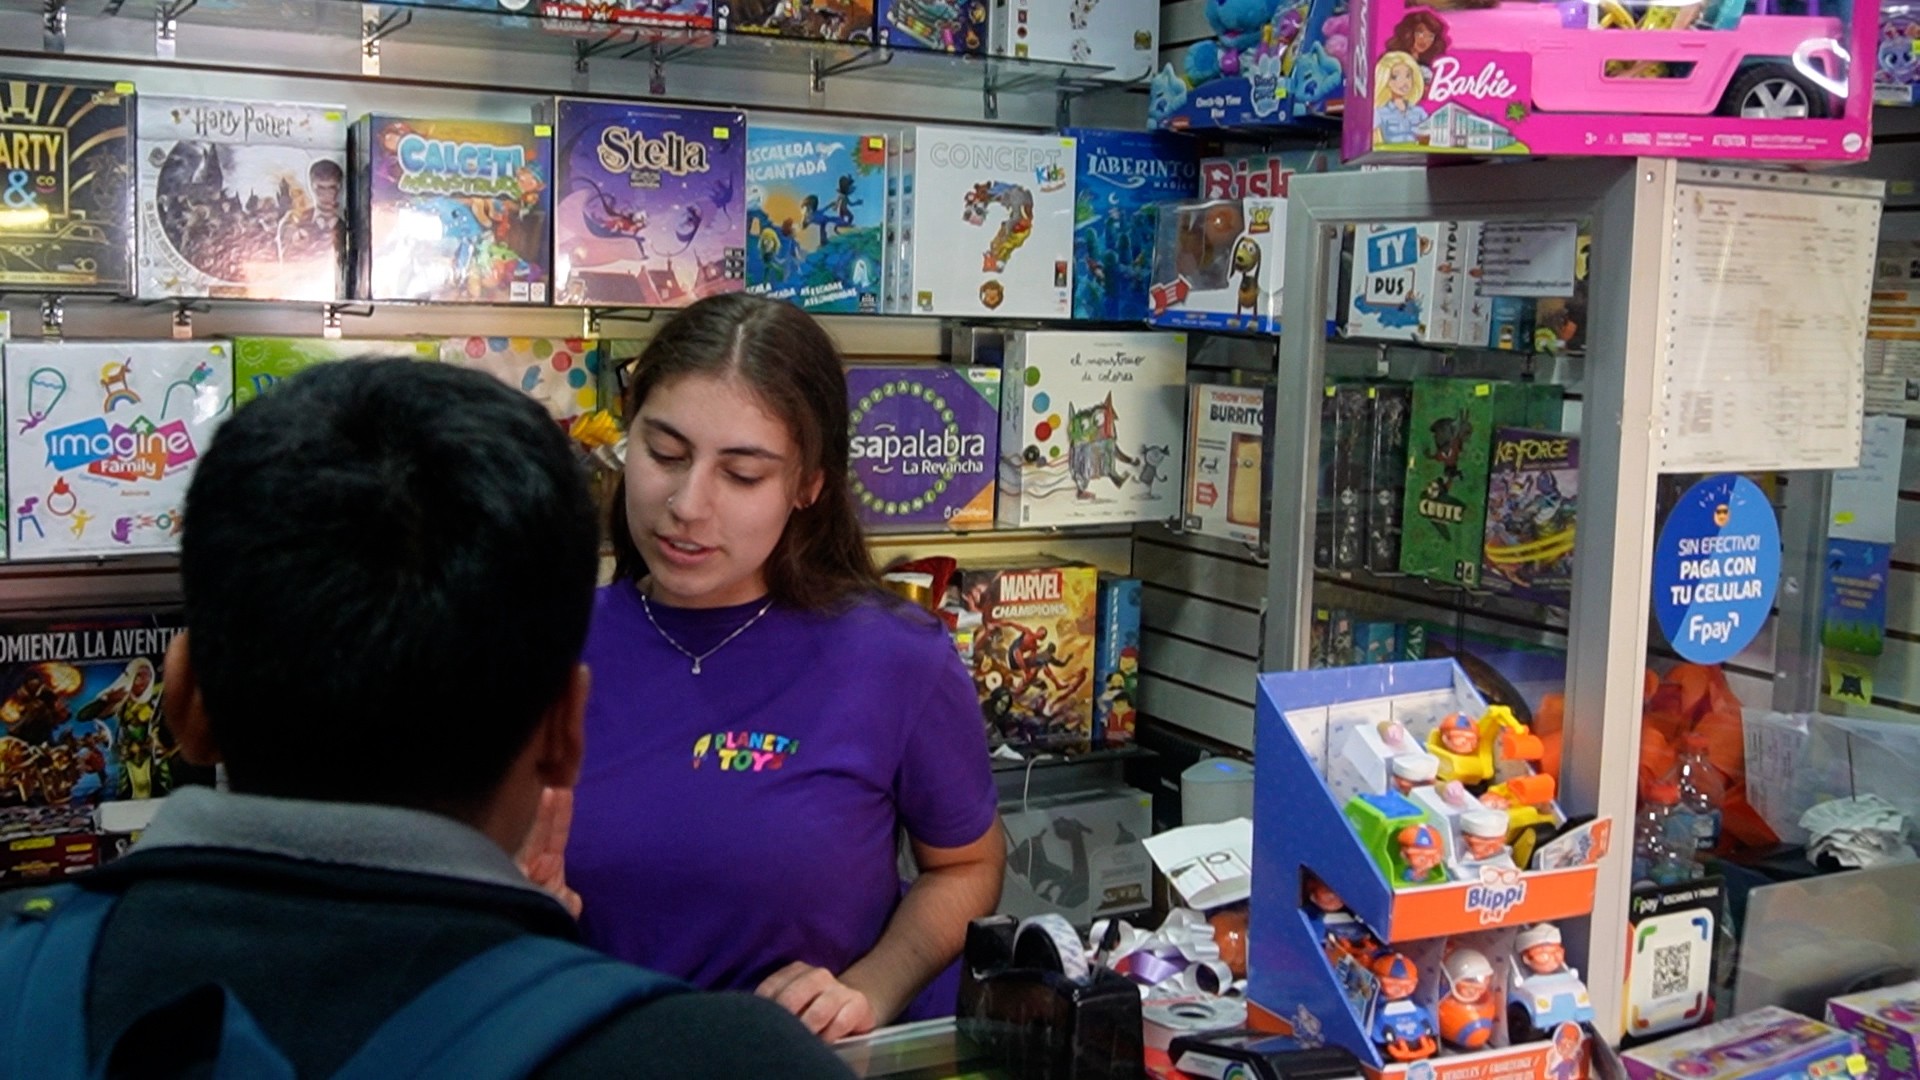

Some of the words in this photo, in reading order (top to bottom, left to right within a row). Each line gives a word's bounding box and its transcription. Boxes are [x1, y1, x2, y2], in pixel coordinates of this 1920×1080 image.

[1428, 57, 1518, 101] Barbie
[194, 106, 240, 136] Harry
[244, 105, 294, 142] Potter
[598, 126, 710, 175] Stella
[930, 142, 1061, 172] CONCEPT
[1035, 163, 1066, 184] Kids
[1087, 153, 1195, 178] LABERINTO
[1203, 159, 1294, 199] Risk
[1376, 232, 1407, 268] TY
[1070, 352, 1082, 367] el
[52, 431, 190, 461] imagine
[850, 429, 985, 464] sapalabra
[1494, 439, 1570, 471] KEYFORGE
[100, 460, 157, 474] Family
[902, 460, 918, 474] La
[922, 459, 984, 474] Revancha
[1678, 539, 1698, 557] SIN
[1701, 535, 1760, 553] EFECTIVO!
[1680, 560, 1720, 580] PAGA
[1724, 556, 1755, 576] CON
[1000, 573, 1061, 602] MARVEL
[1671, 585, 1692, 605] TU
[1695, 580, 1762, 603] CELULAR
[991, 603, 1067, 618] CHAMPIONS
[1689, 612, 1740, 645] Fpay
[83, 631, 107, 658] LA
[1468, 883, 1524, 909] Blippi
